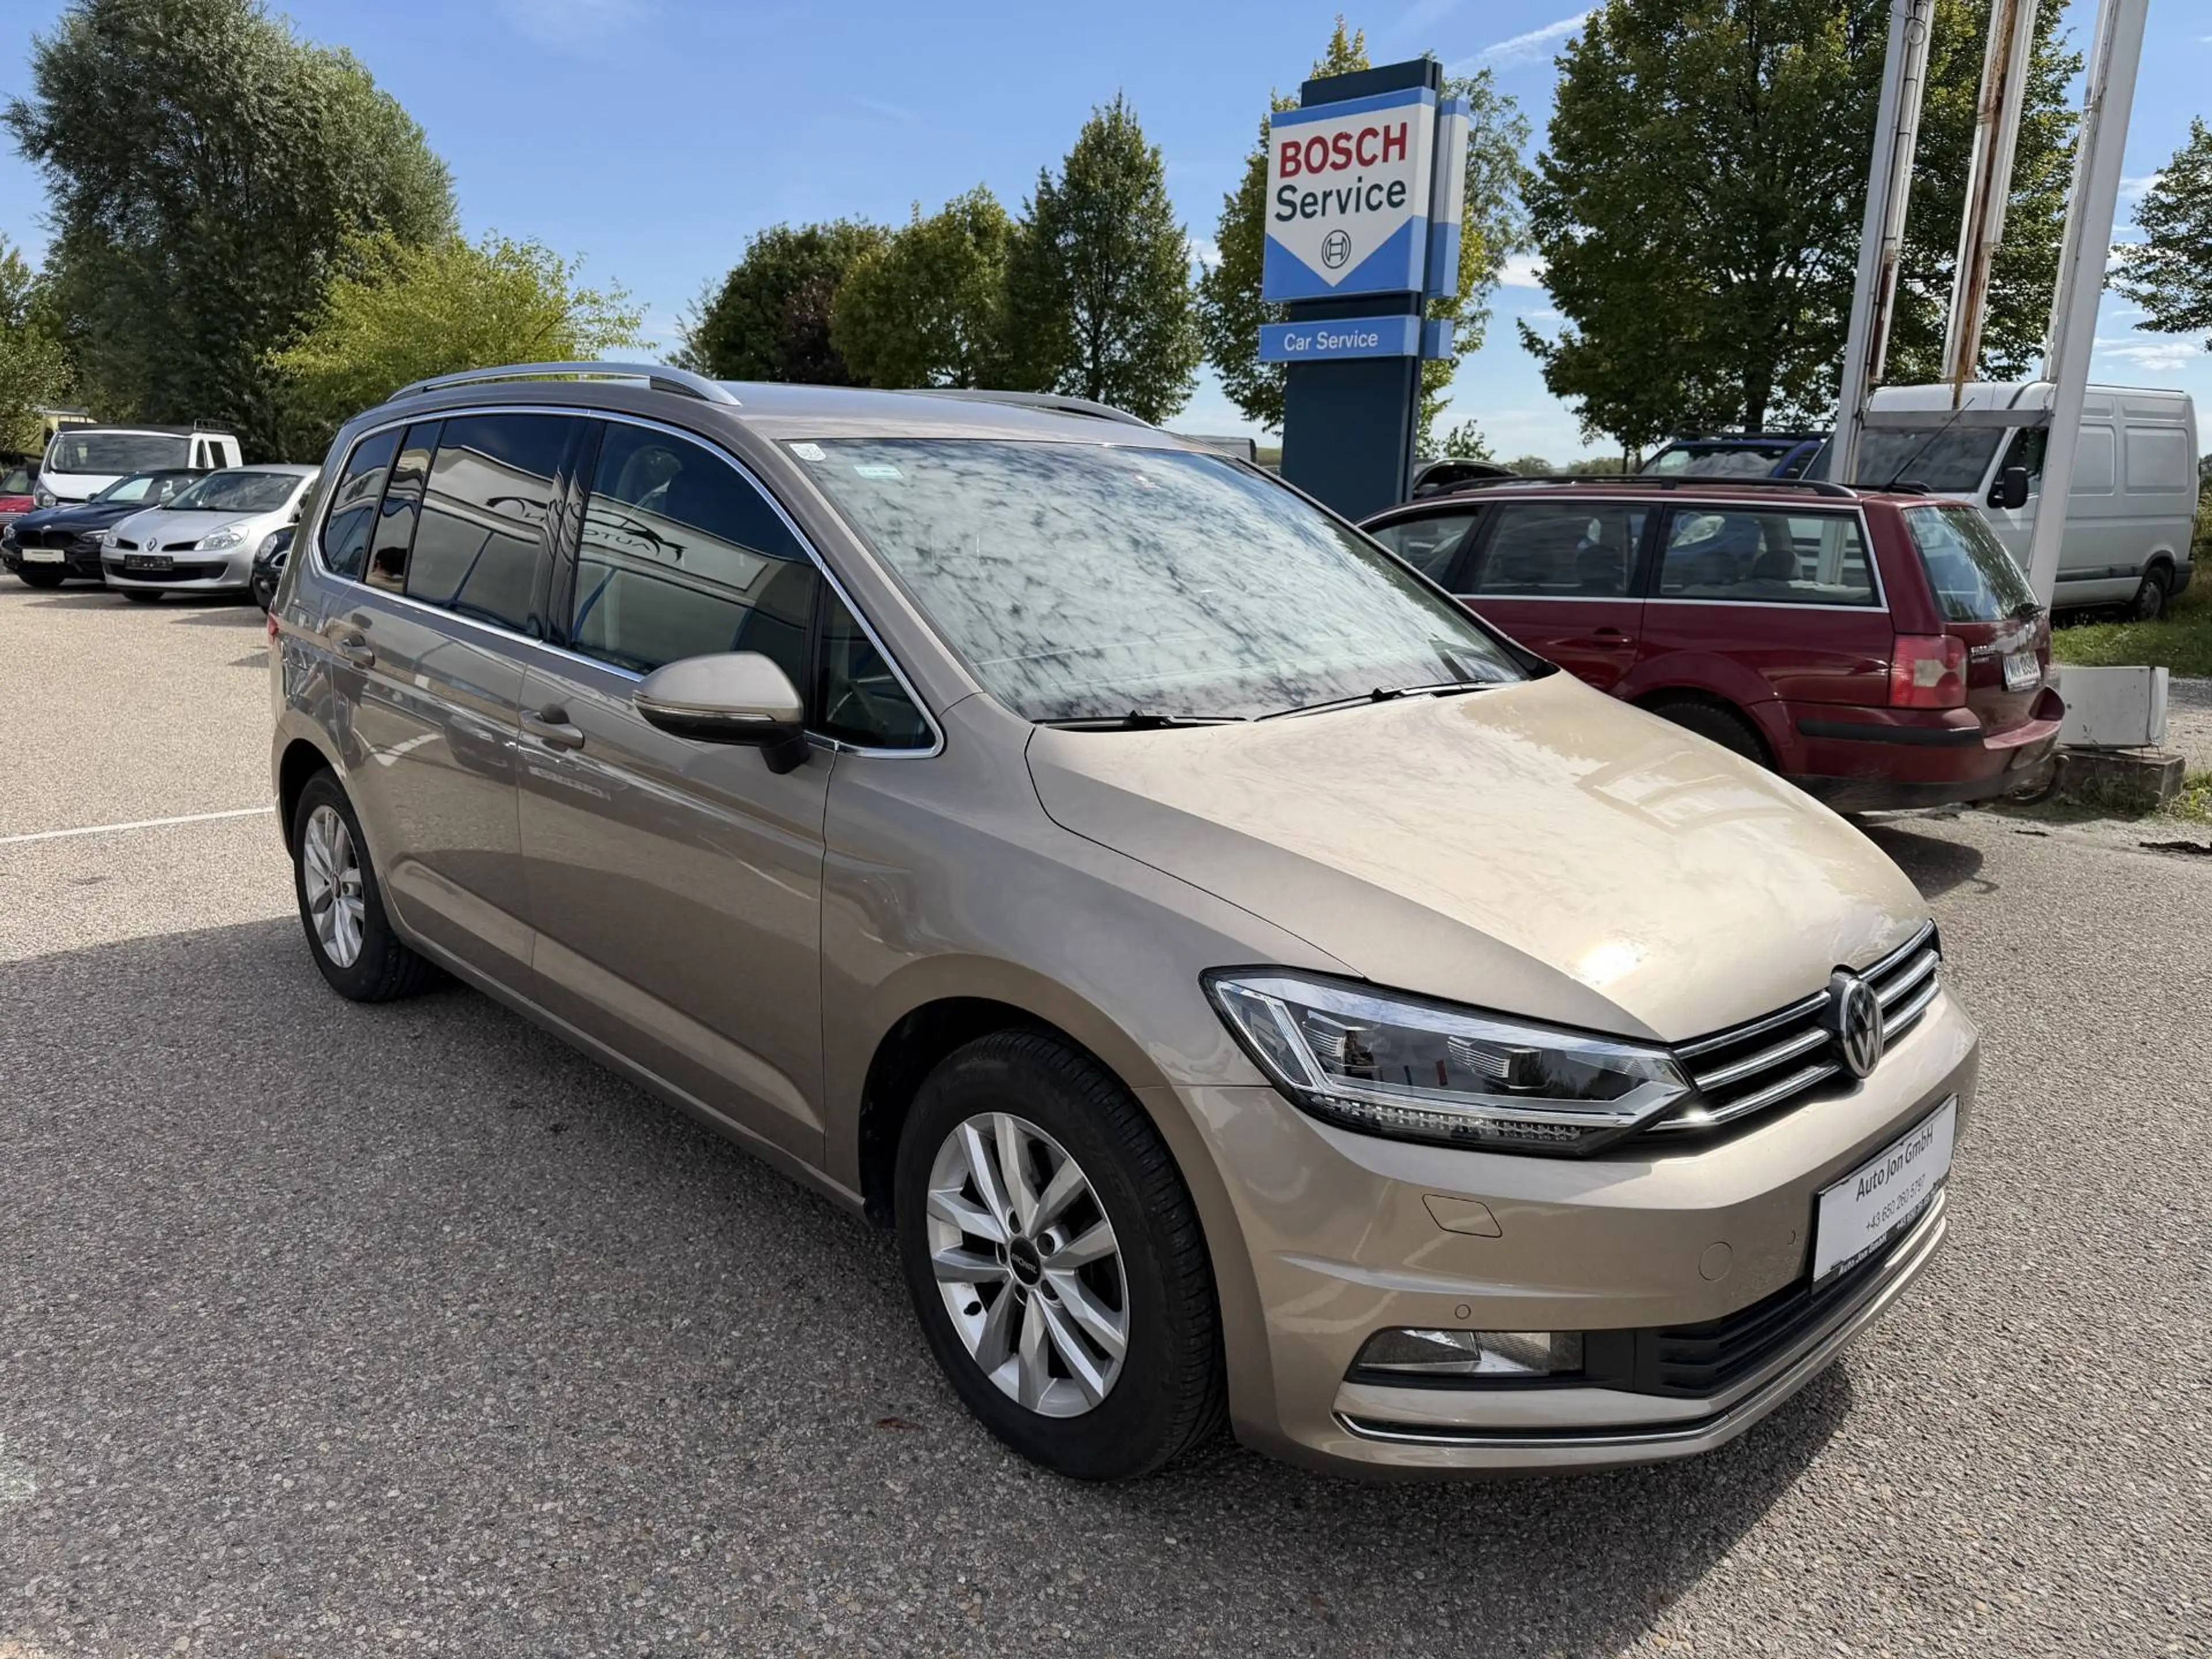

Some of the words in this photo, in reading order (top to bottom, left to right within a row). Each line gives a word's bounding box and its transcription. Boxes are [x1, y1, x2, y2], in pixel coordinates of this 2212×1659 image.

[1279, 122, 1407, 178] BOSCH
[1275, 176, 1406, 222] Service
[1284, 333, 1312, 351] Car
[1316, 329, 1378, 350] Service
[1855, 1169, 1884, 1202] Auto
[1885, 1153, 1903, 1185] Jon
[1905, 1123, 1933, 1164] GmbH
